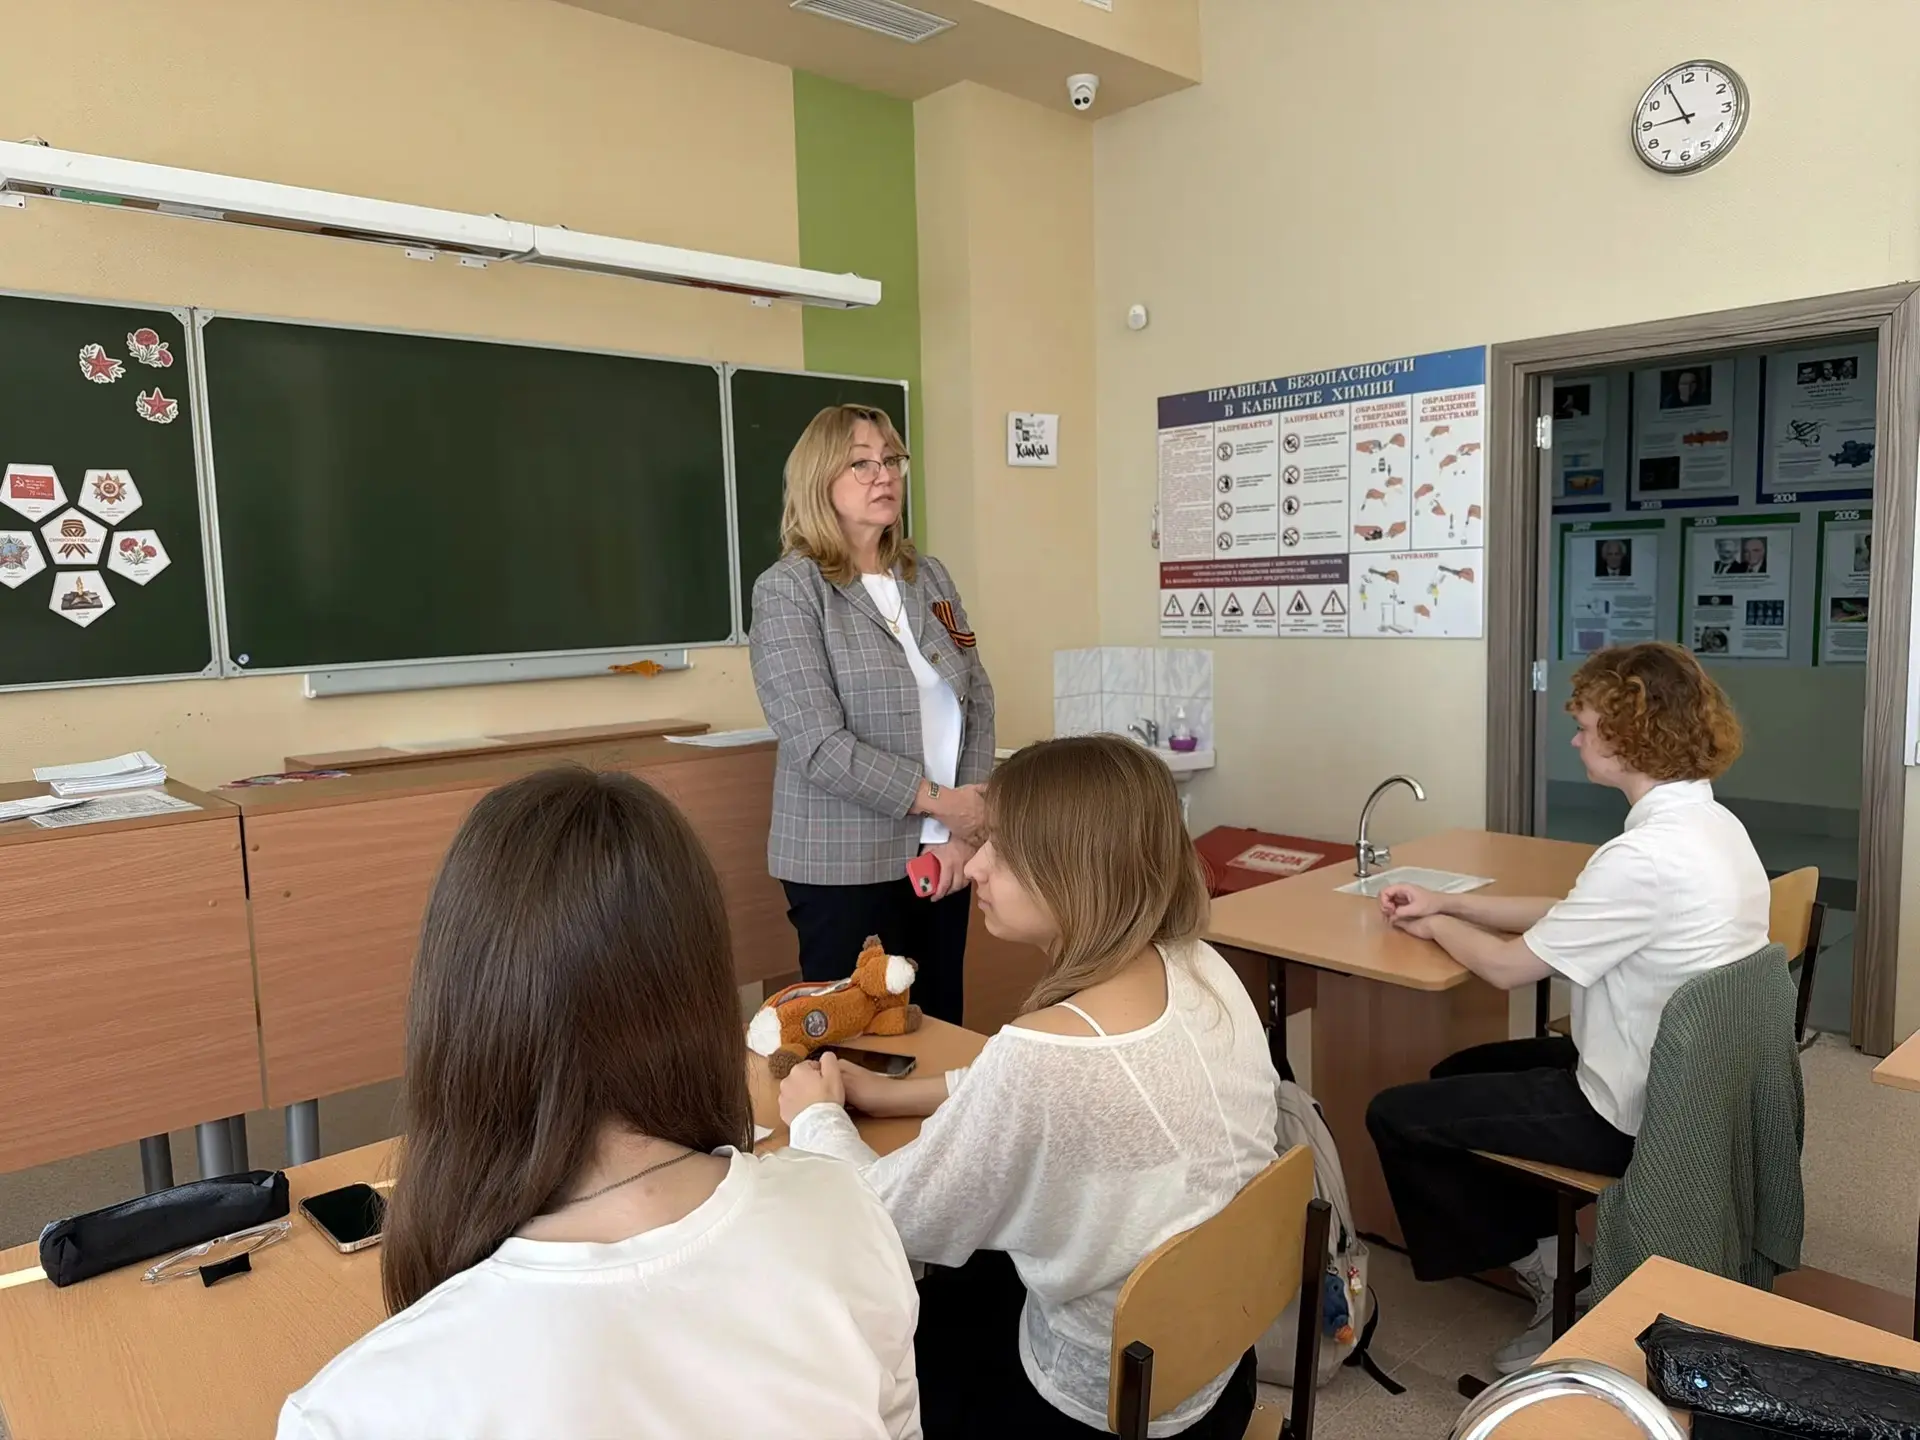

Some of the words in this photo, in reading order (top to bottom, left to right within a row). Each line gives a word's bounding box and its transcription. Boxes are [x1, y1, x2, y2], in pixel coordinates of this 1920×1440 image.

[1681, 72, 1695, 84] 12
[1705, 72, 1709, 82] 1
[1663, 84, 1672, 95] 11
[1715, 83, 1726, 95] 2
[1649, 100, 1660, 112] 10
[1721, 101, 1732, 113] 3
[1642, 121, 1653, 131] 9
[1714, 121, 1725, 132] 4
[1647, 138, 1660, 149] 8
[1700, 140, 1711, 151] 5
[1662, 149, 1672, 160] 7
[1680, 150, 1691, 161] 6
[1208, 380, 1278, 403] ПРАВИЛА
[1287, 357, 1416, 391] БЕЗОПАСНОСТИ
[1224, 403, 1234, 418] В
[1242, 389, 1322, 415] КАБИНЕТЕ
[1331, 379, 1394, 402] ХИМИИ
[1421, 391, 1476, 405] ОБРАЩЕНИЕ
[1355, 401, 1406, 414] ОБРАЩЕНИЕ
[1421, 406, 1428, 414] С
[1284, 408, 1345, 425] ЗАПРЕЩАЕТСЯ
[1773, 493, 1797, 503] 2004
[1834, 510, 1860, 521] 2005
[1248, 851, 1306, 866] ПЕСОК
